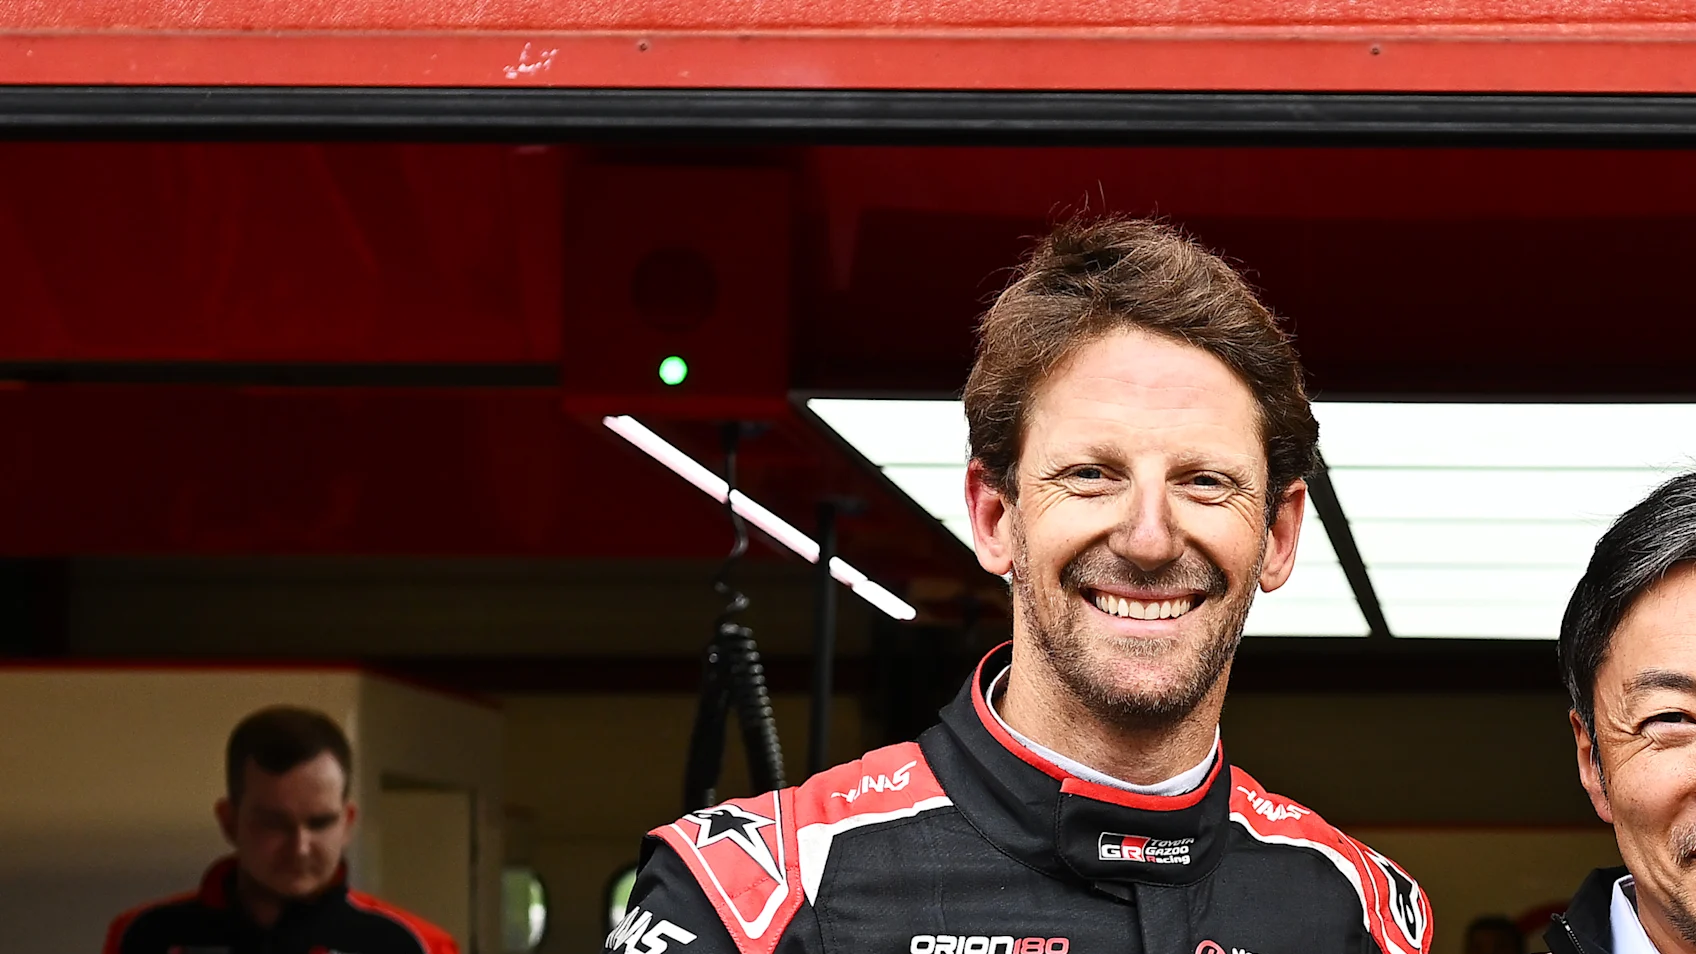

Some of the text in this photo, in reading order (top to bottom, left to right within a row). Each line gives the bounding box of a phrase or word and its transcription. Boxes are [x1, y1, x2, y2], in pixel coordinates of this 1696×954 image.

[831, 760, 917, 803] HAAS
[1237, 786, 1310, 821] HAAS
[1150, 838, 1195, 848] TOYOTA
[1101, 844, 1144, 861] GR
[1145, 846, 1189, 856] GAZOO
[1146, 855, 1191, 865] Racing
